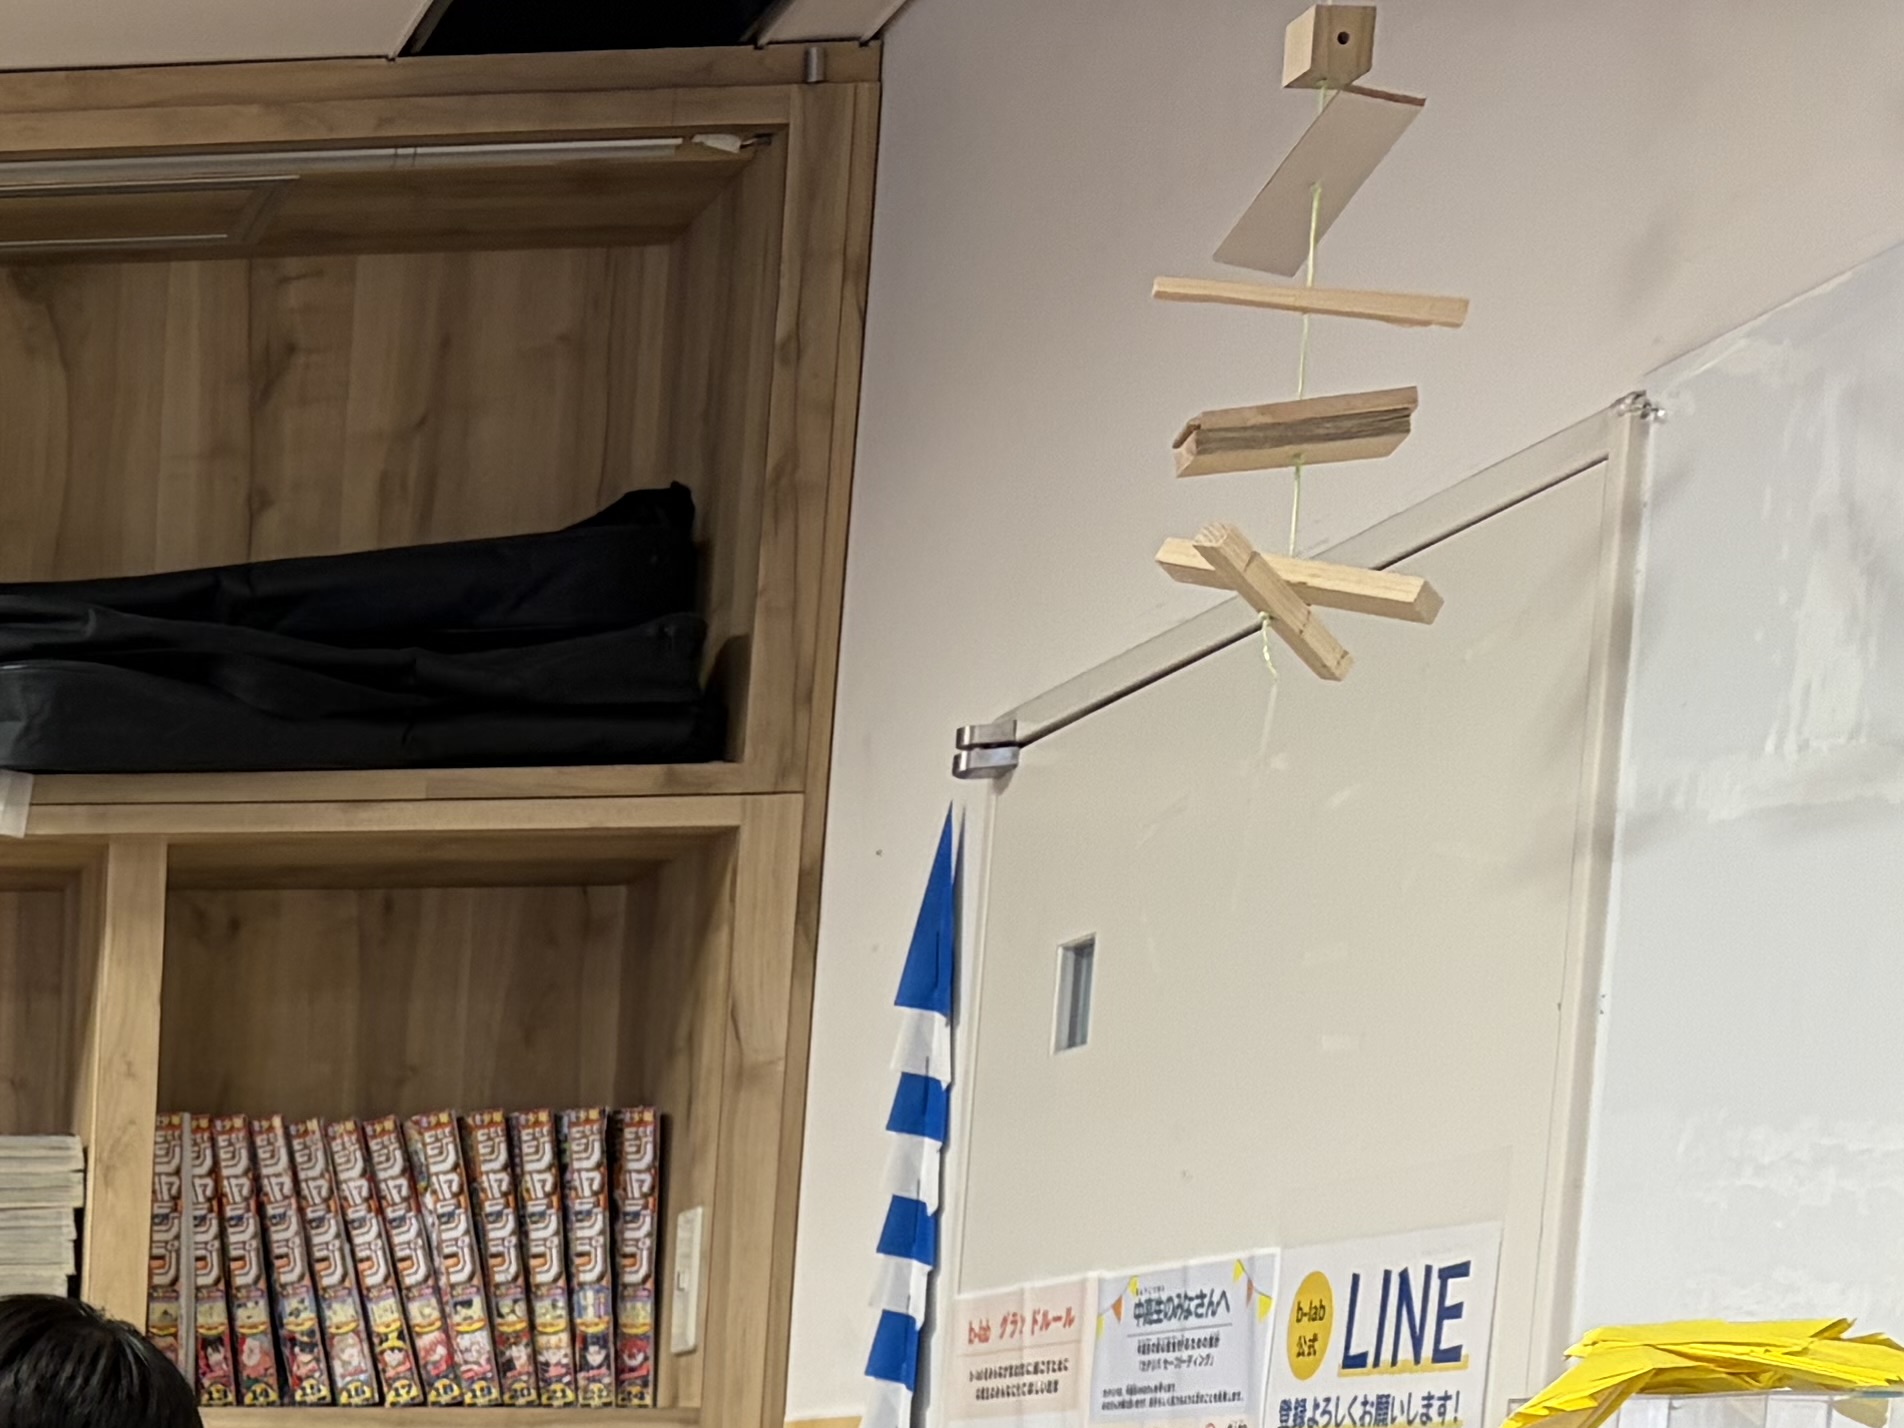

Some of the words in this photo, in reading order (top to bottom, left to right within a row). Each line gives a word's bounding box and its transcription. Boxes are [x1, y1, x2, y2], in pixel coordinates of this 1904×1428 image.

[1296, 1299, 1326, 1324] b-lab
[1342, 1260, 1471, 1369] LINE
[1296, 1333, 1318, 1358] 公式
